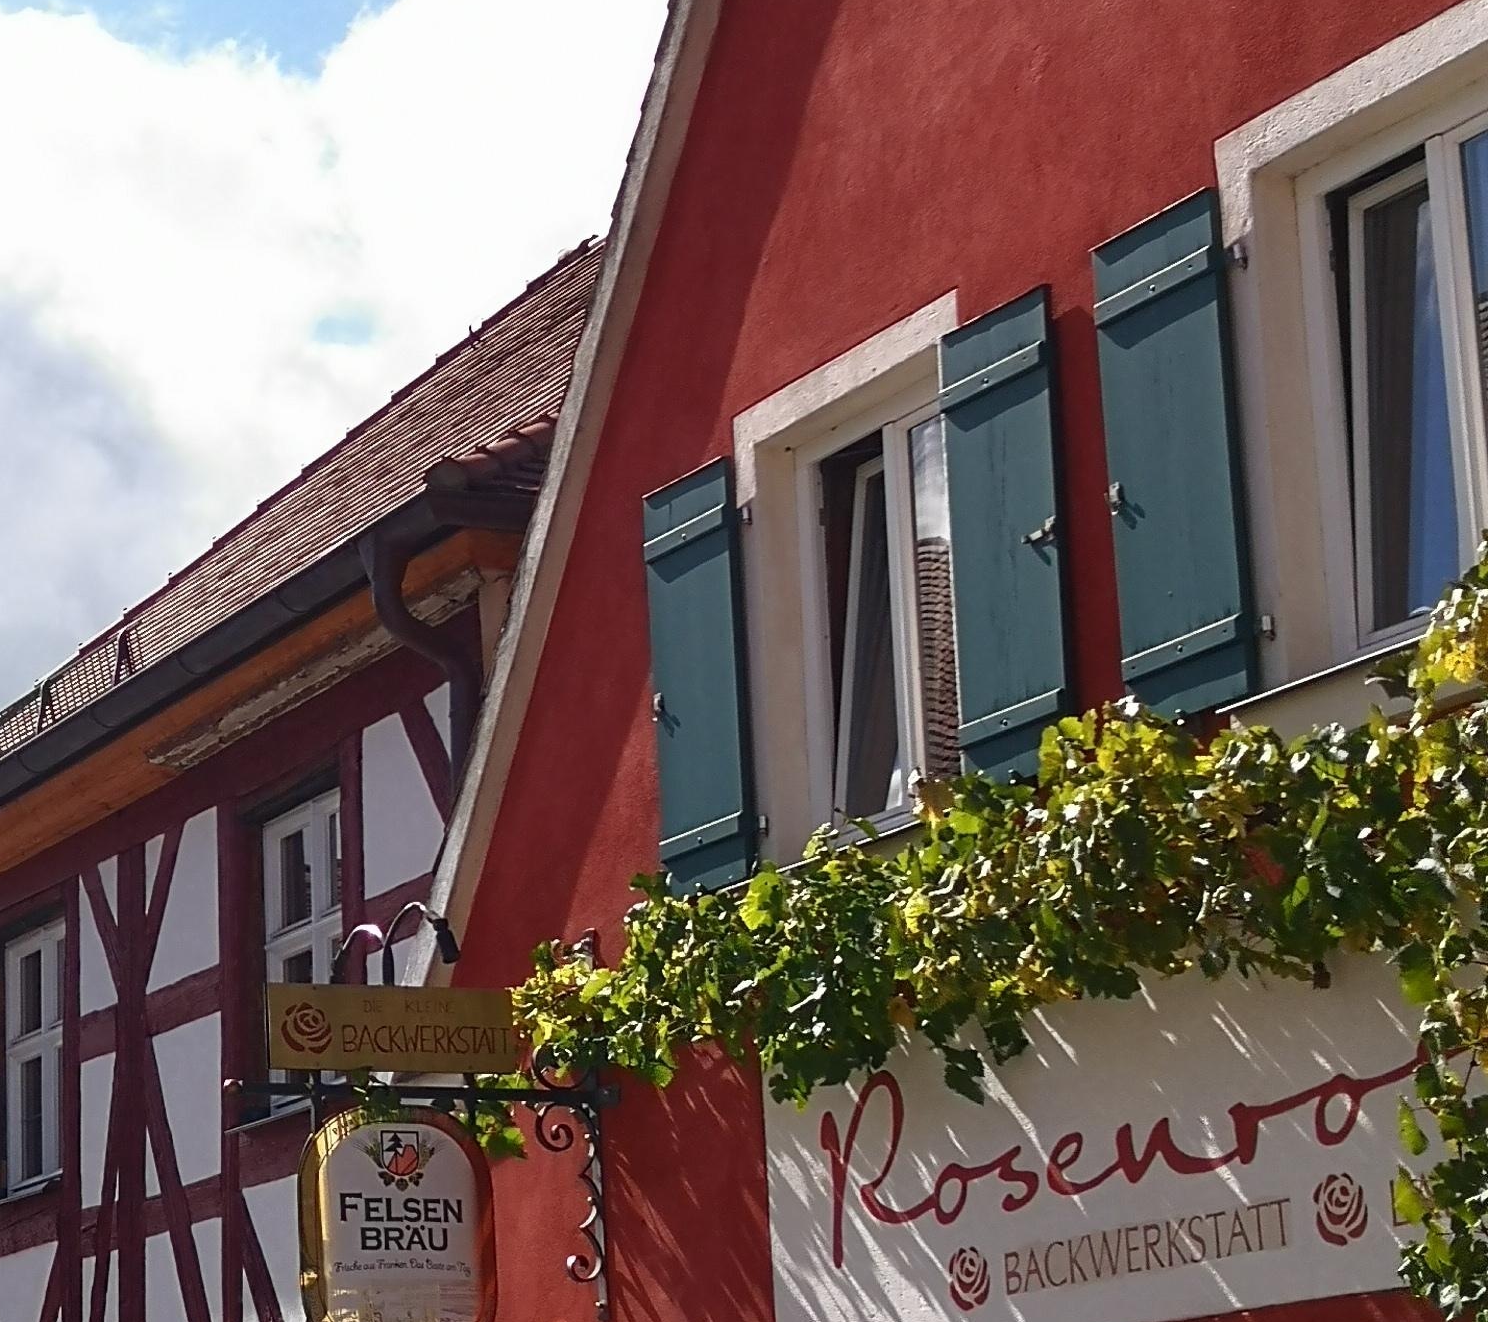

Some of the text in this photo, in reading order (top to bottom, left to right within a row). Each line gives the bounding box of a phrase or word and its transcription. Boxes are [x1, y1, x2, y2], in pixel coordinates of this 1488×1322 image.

[363, 999, 456, 1014] DIE KLEINE
[342, 1024, 511, 1055] BACKWERKSTATT
[339, 1192, 464, 1224] FELSEN
[360, 1224, 449, 1251] BRÄU
[1003, 1198, 1293, 1296] BACKWERKSTATT
